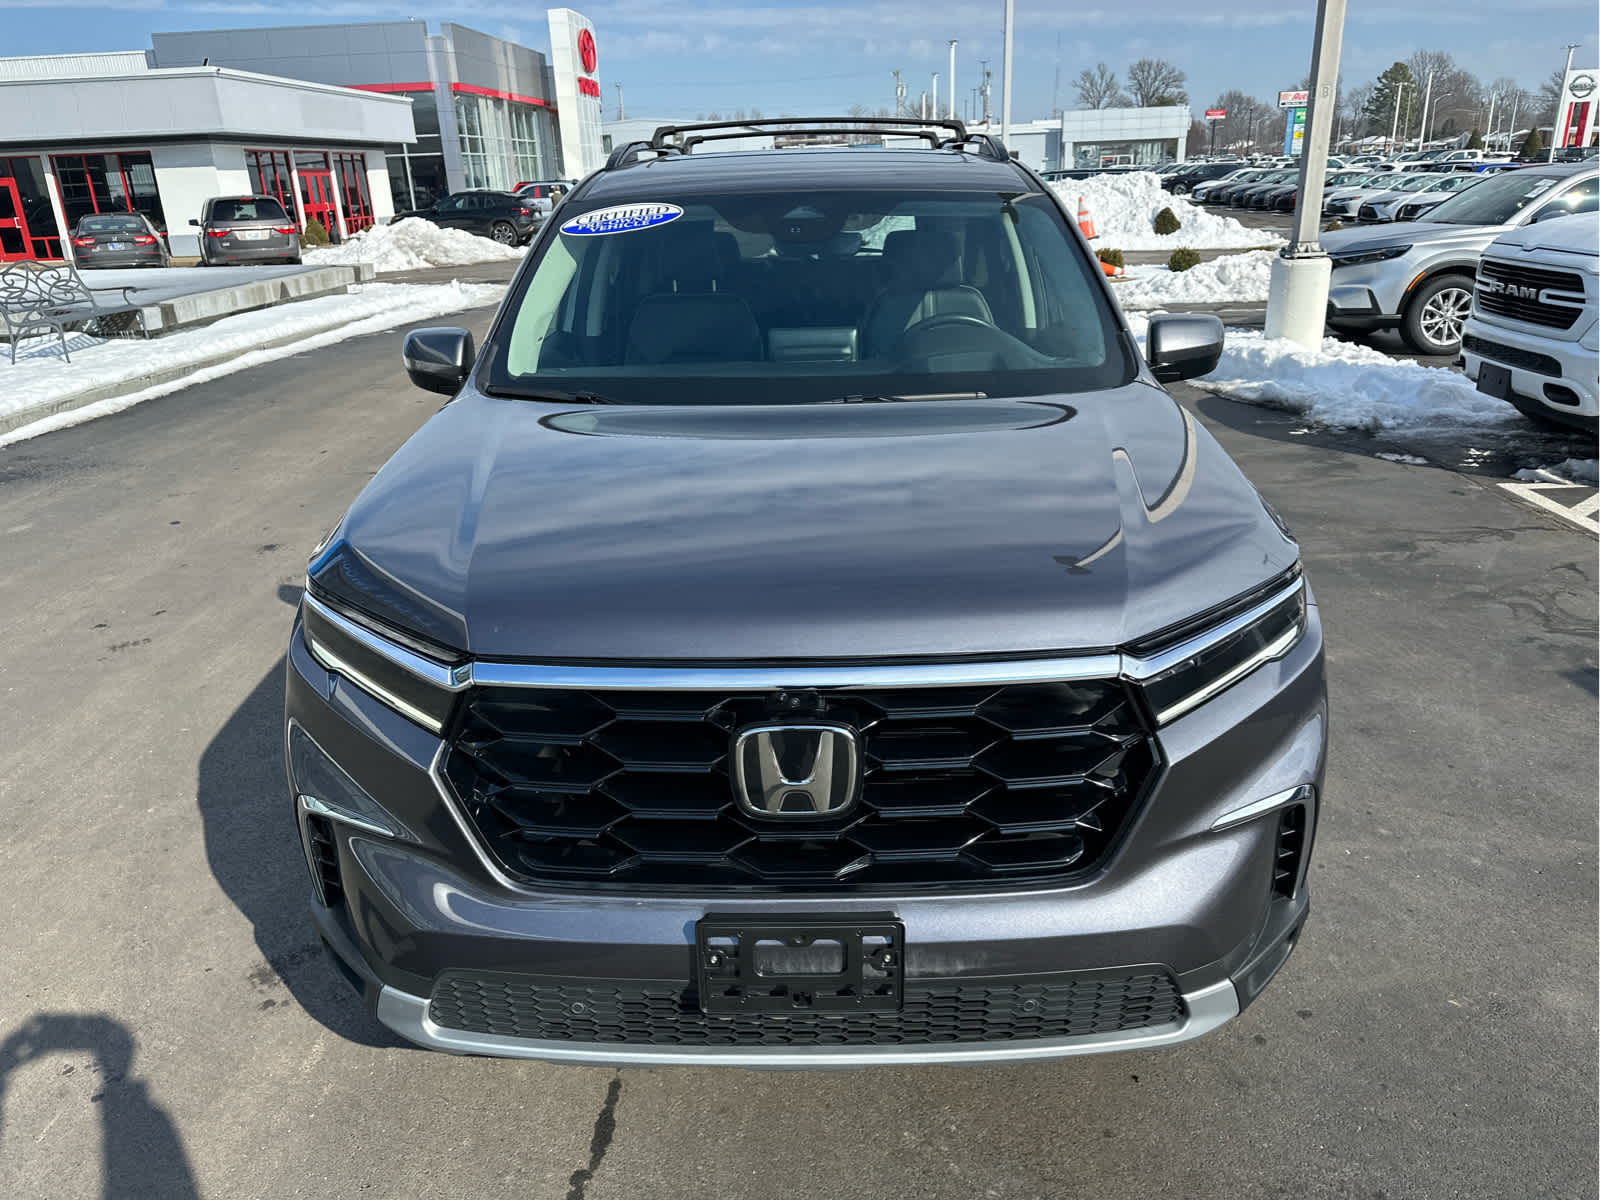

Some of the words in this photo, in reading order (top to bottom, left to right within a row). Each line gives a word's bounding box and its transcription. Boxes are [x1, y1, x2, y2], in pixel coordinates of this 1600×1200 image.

[575, 206, 670, 225] CERTIFIED
[577, 213, 664, 231] PRE-OWNED
[590, 220, 650, 233] VEHICLE
[1493, 281, 1538, 300] RAM
